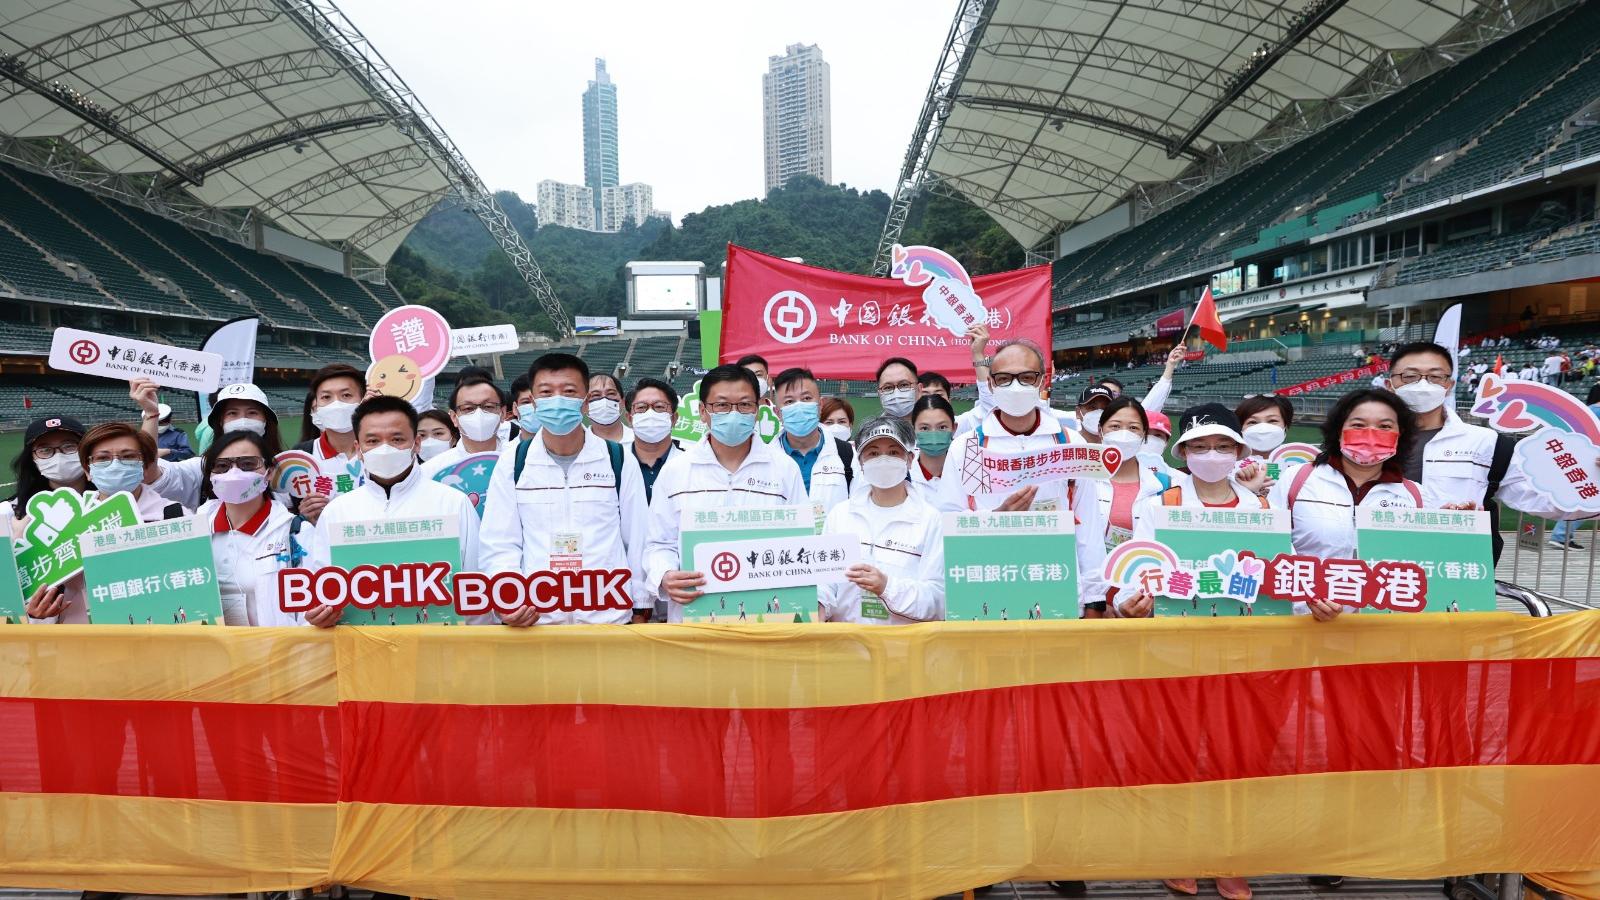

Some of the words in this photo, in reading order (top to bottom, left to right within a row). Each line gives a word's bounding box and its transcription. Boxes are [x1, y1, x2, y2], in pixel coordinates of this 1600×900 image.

[829, 297, 1011, 331] 中國銀港)
[939, 285, 975, 326] 中銀香港
[390, 316, 429, 354] 讚
[828, 334, 870, 345] BANK
[874, 335, 893, 346] OF
[897, 335, 946, 347] CHINA
[105, 362, 129, 372] BANK
[143, 368, 170, 379] CHINA
[983, 447, 1101, 472] 中銀香港步步顯關愛
[1545, 438, 1599, 500] 中銀香港
[18, 510, 122, 589] 萬步齊碳
[746, 547, 846, 569] 中國銀行(香港)
[92, 567, 211, 602] 中國銀行(香港)
[283, 567, 448, 608] BOCHK
[748, 570, 771, 579] BANK
[772, 569, 782, 577] OF
[785, 567, 812, 576] CHINA
[949, 563, 1069, 583] 中國銀行(香港)
[1138, 567, 1258, 598] 行善最帥
[458, 573, 628, 611] BOCHK
